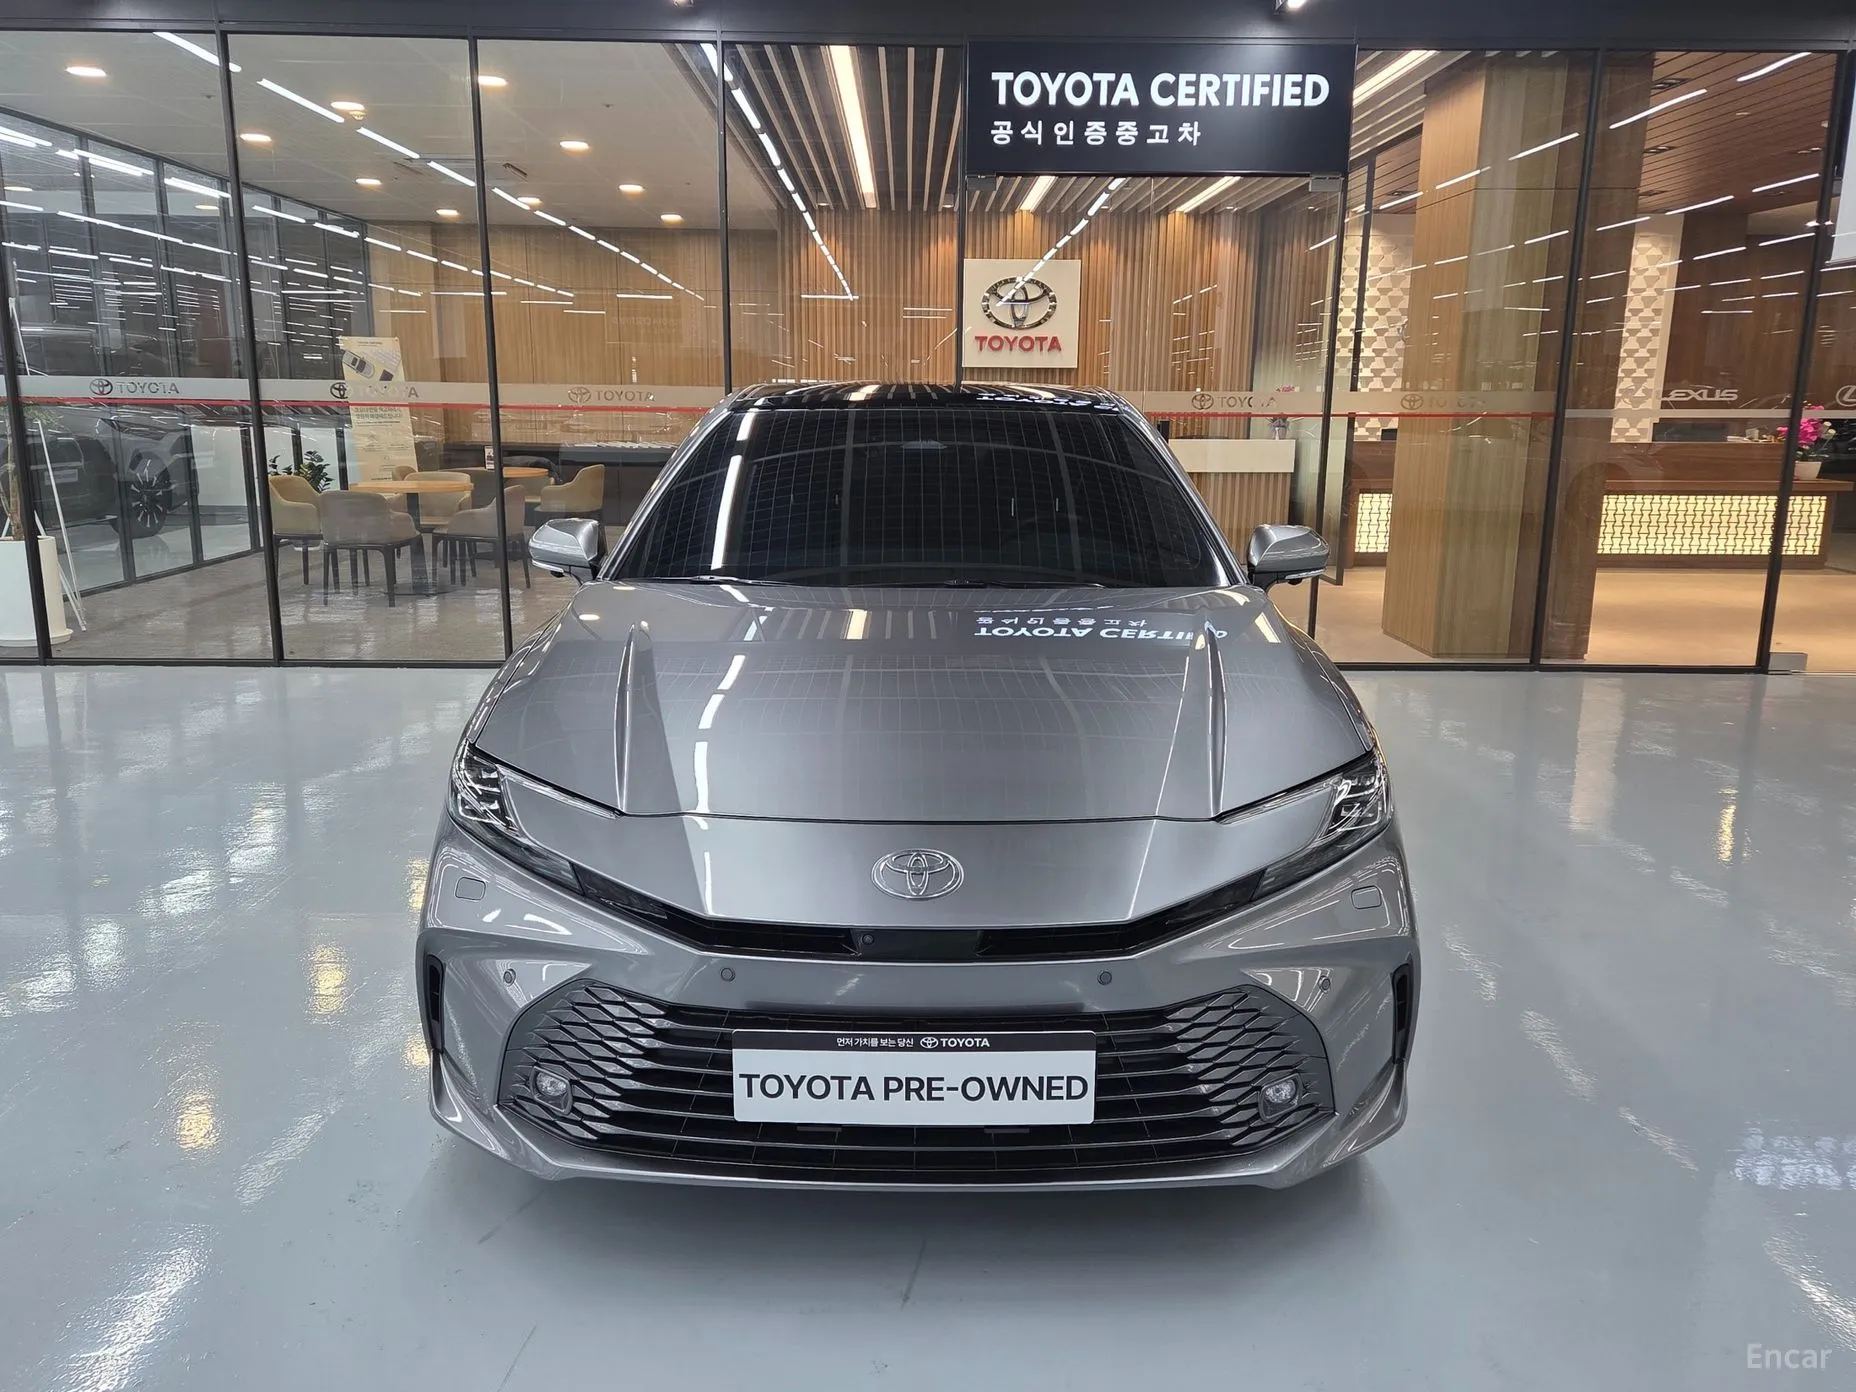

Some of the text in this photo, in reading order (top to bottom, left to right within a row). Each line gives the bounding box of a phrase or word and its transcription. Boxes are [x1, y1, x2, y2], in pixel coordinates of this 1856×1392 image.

[991, 71, 1330, 107] TOYOTA CERTIFIED
[990, 120, 1201, 146] 공식인증중고차
[974, 335, 1062, 352] TOYOTA
[115, 381, 180, 394] TOYOTA
[595, 390, 655, 402] TOYOTA
[1656, 389, 1739, 401] EXUS
[836, 1037, 914, 1048] 먼저 가치를 보는 당신
[940, 1038, 990, 1047] TOYOTA
[739, 1073, 1088, 1101] TOYOTA PRE-OWNED
